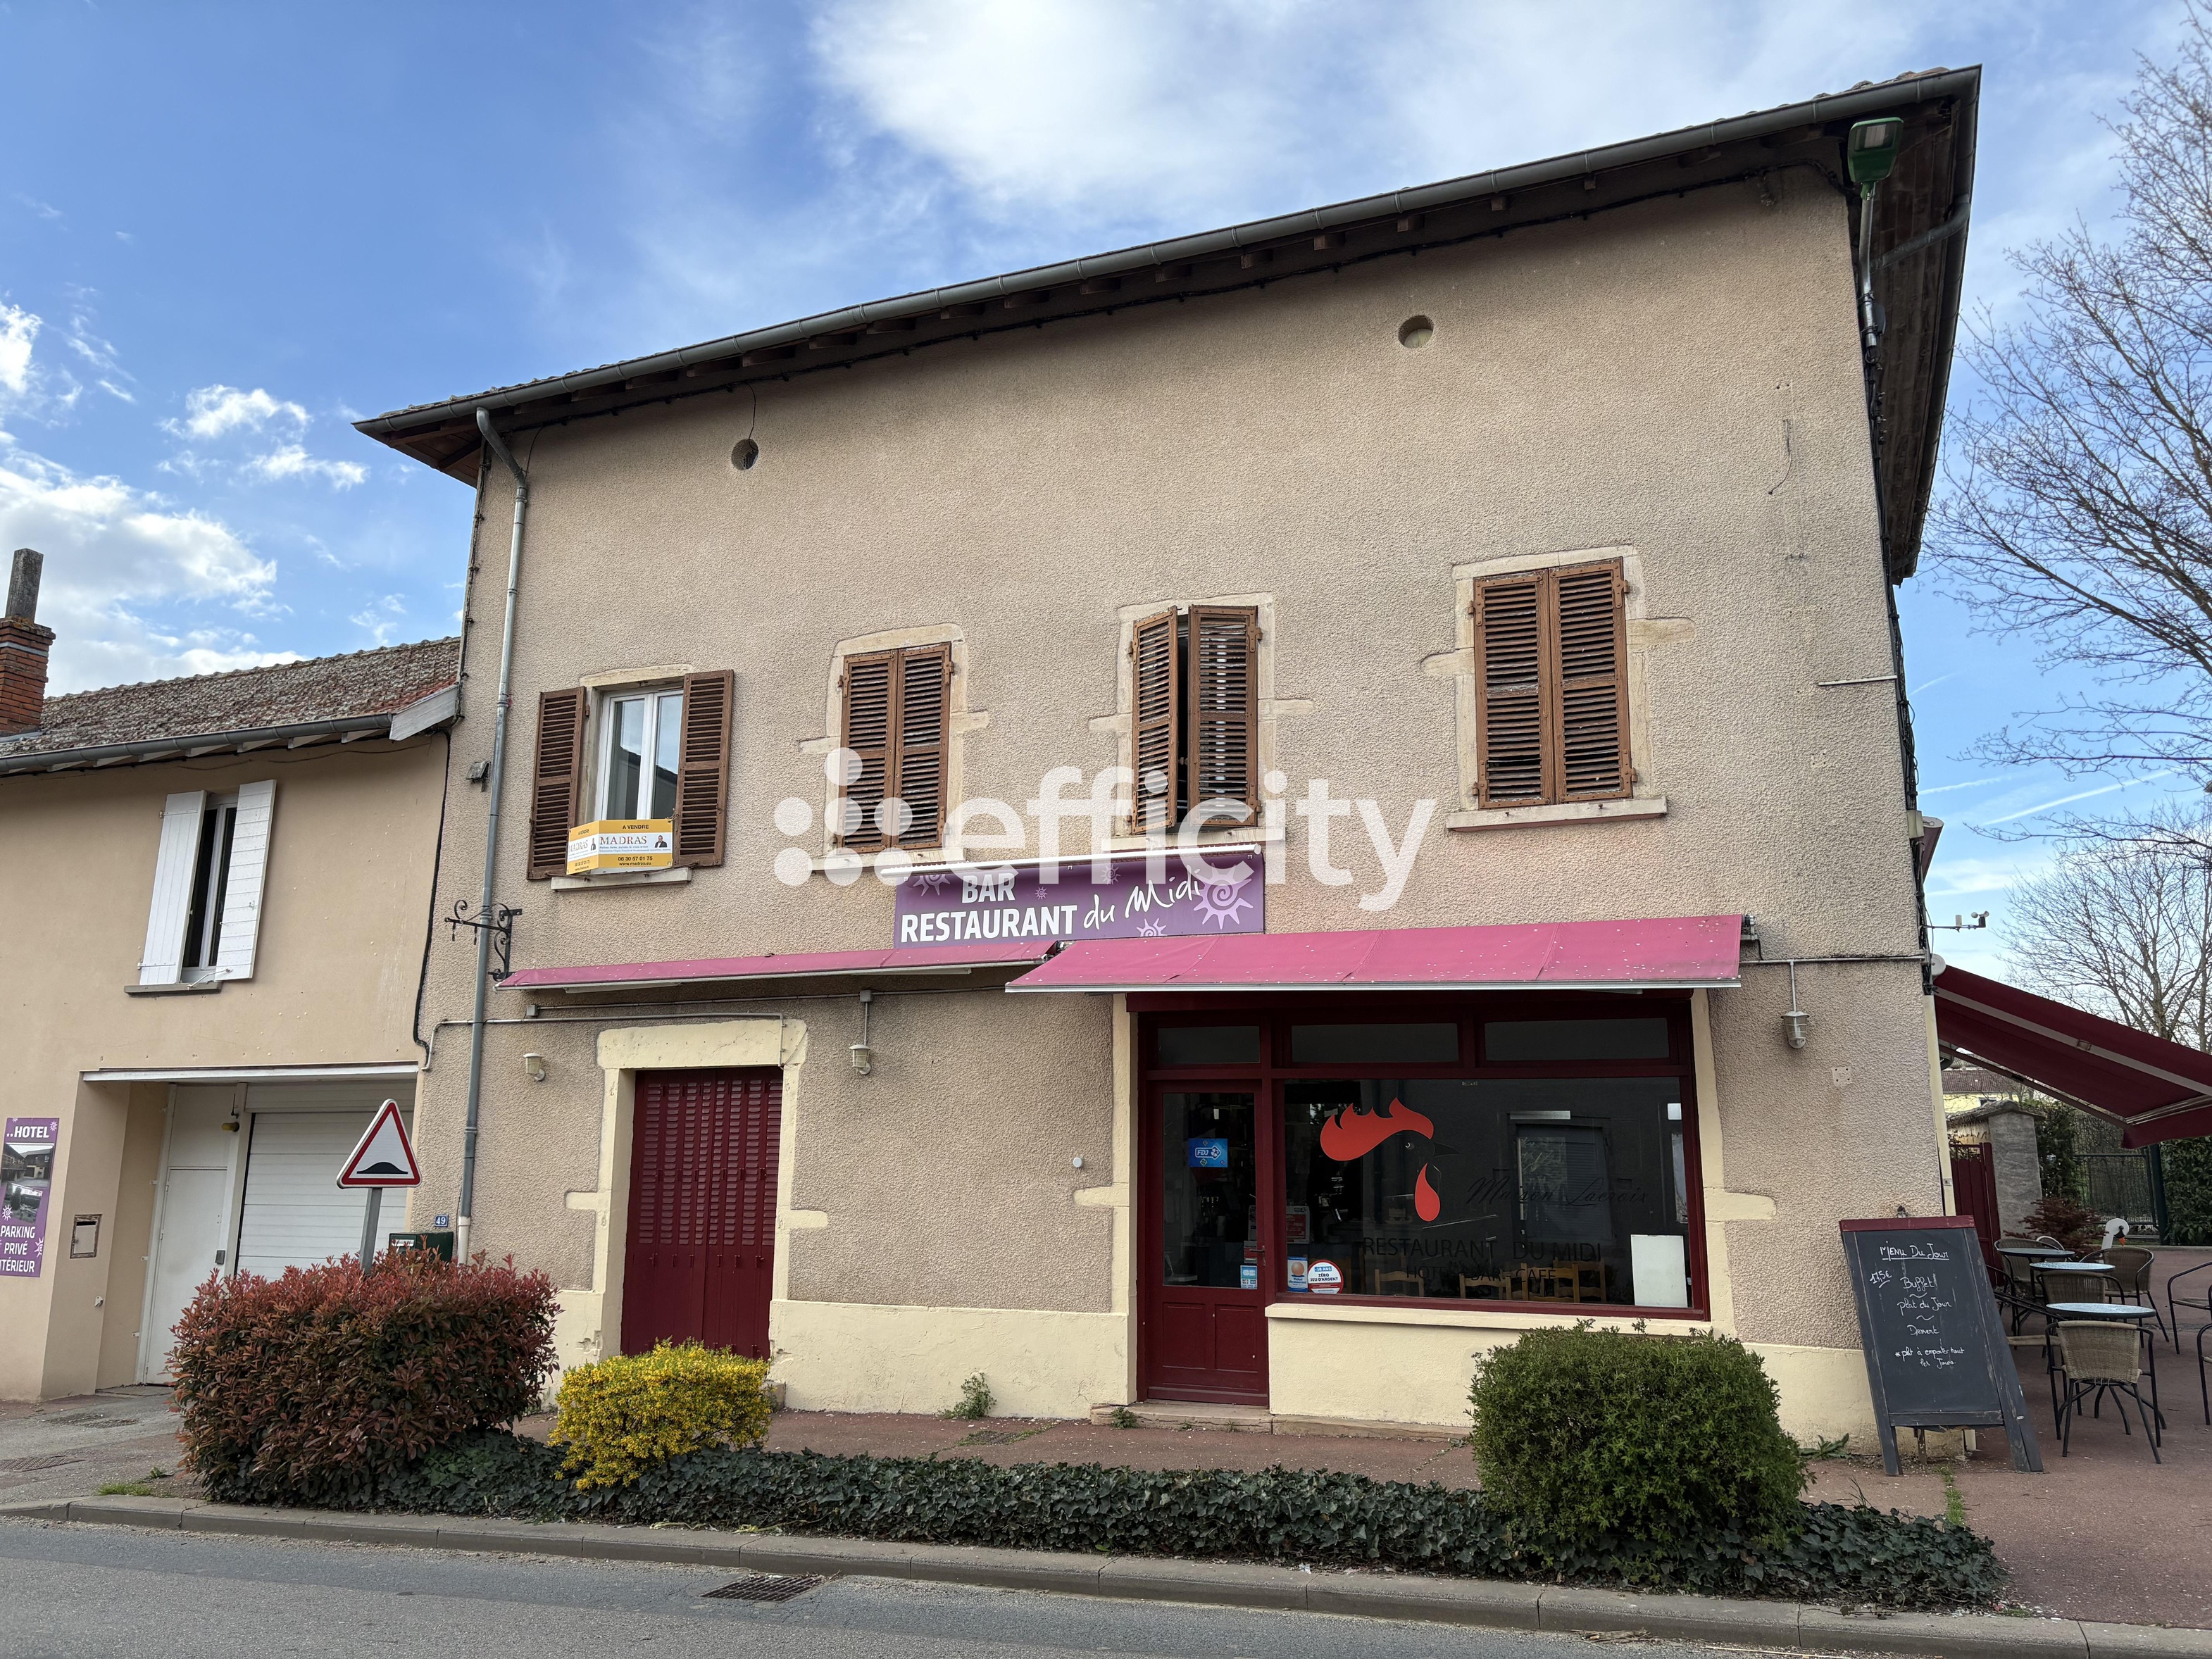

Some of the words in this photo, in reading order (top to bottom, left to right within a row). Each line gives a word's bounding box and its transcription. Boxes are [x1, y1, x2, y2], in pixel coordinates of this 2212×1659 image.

[600, 836, 647, 845] MADRAS
[961, 872, 1016, 903] BAR
[901, 904, 1077, 943] RESTAURANT
[1083, 894, 1116, 930] du
[1125, 865, 1201, 919] Midi
[435, 1216, 446, 1225] 49
[0, 1225, 36, 1239] PARKING
[4, 1240, 28, 1255] PRIVÉ
[1363, 1237, 1497, 1258] RESTAURANT
[1513, 1241, 1544, 1259] DU
[1553, 1242, 1601, 1261] MIDI
[1926, 1243, 1949, 1260] Jour
[1900, 1276, 1935, 1291] Buffet
[1919, 1299, 1930, 1309] du
[1917, 1346, 1923, 1356] à
